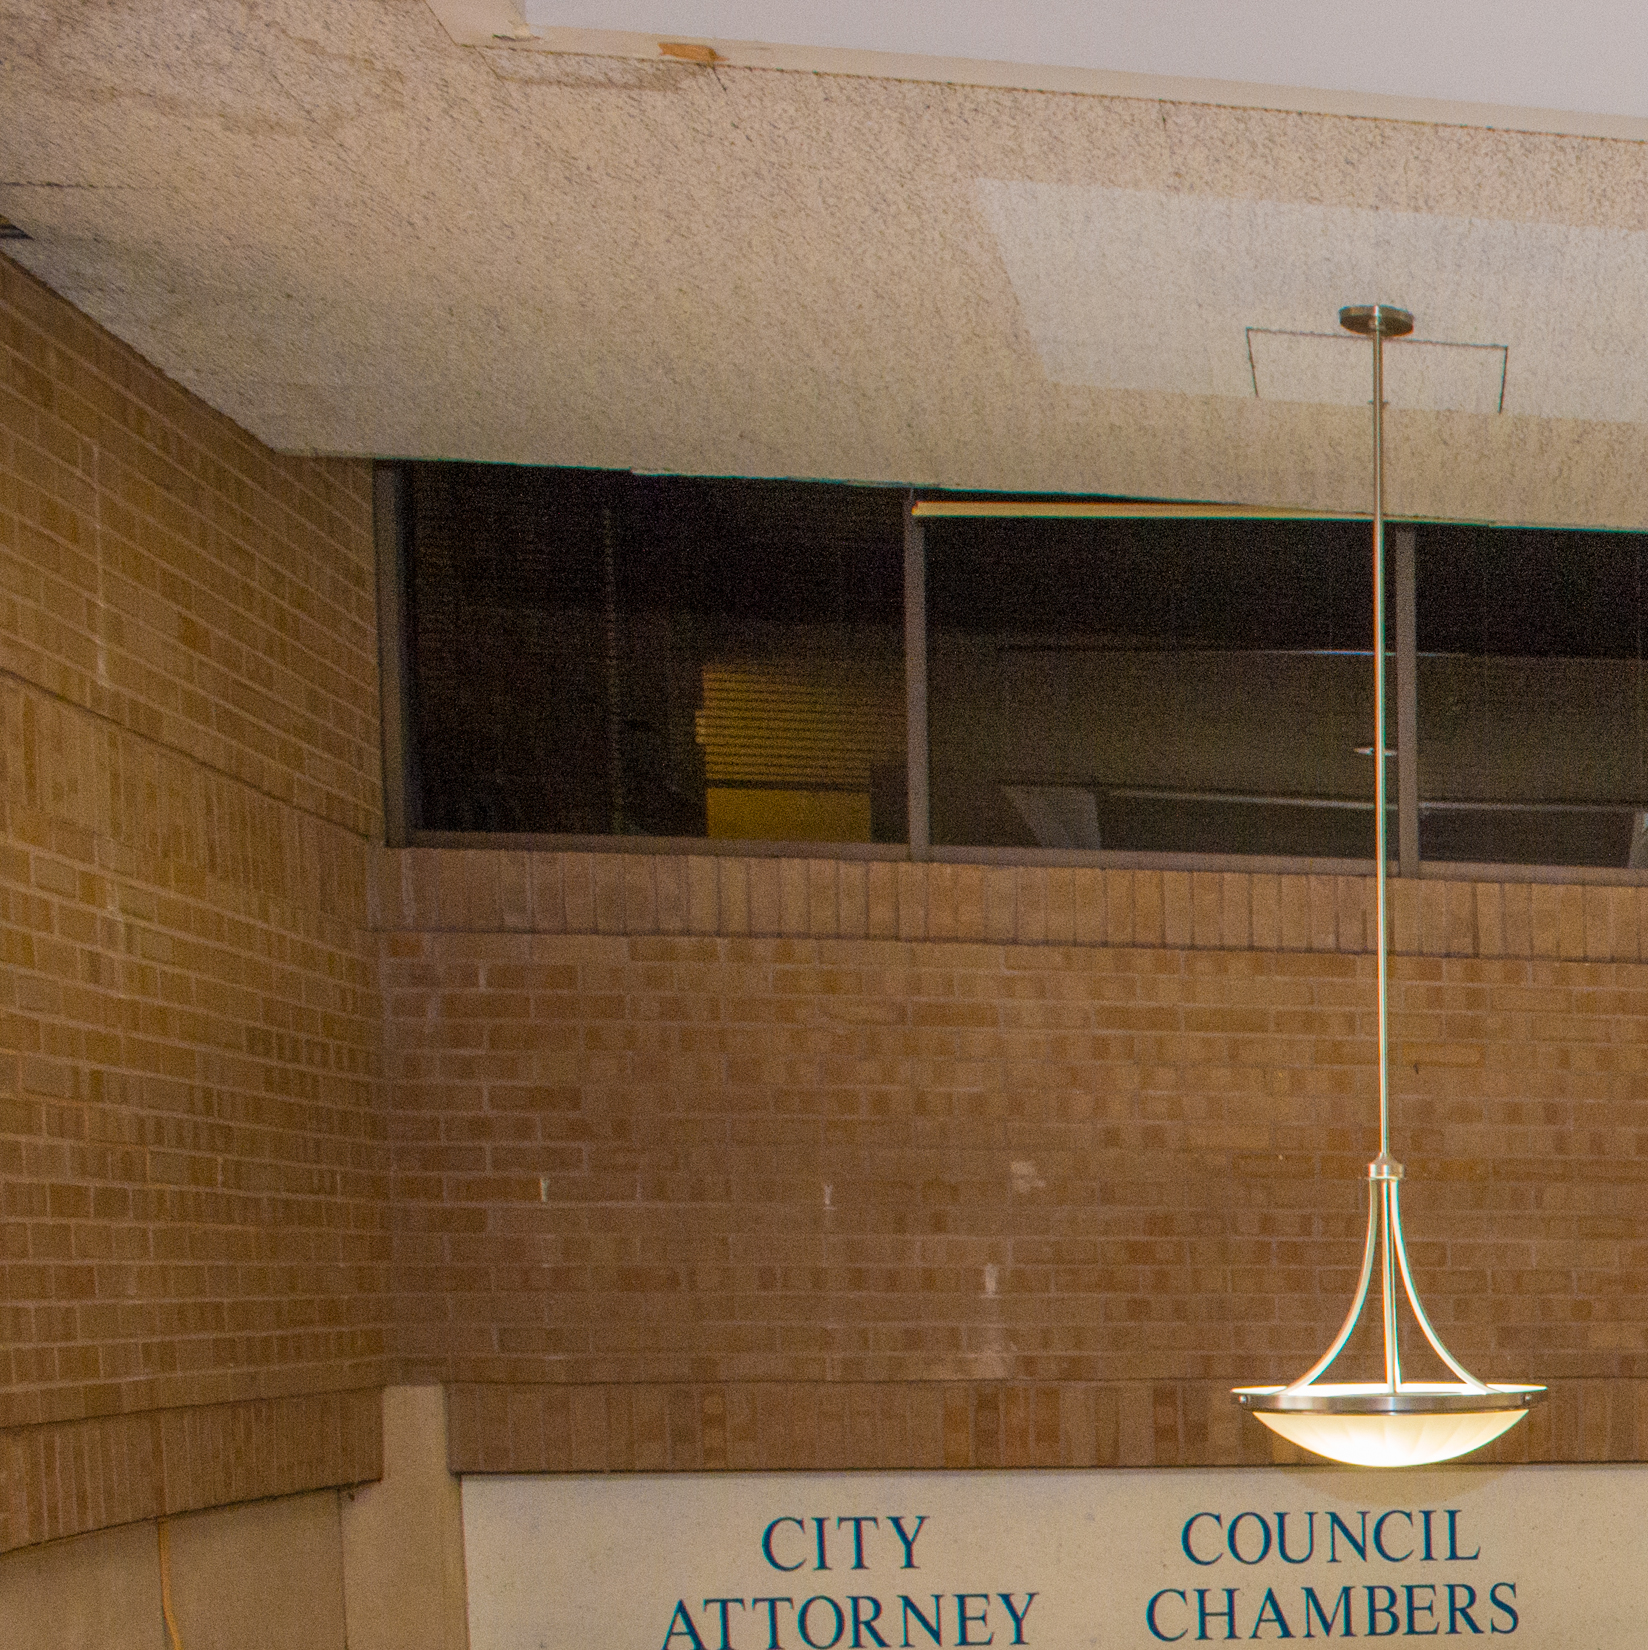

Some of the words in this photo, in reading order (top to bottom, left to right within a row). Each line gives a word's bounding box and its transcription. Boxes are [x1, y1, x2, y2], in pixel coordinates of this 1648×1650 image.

[761, 1515, 930, 1572] CITY
[1180, 1508, 1482, 1567] COUNCIL
[1145, 1581, 1521, 1643] CHAMBERS
